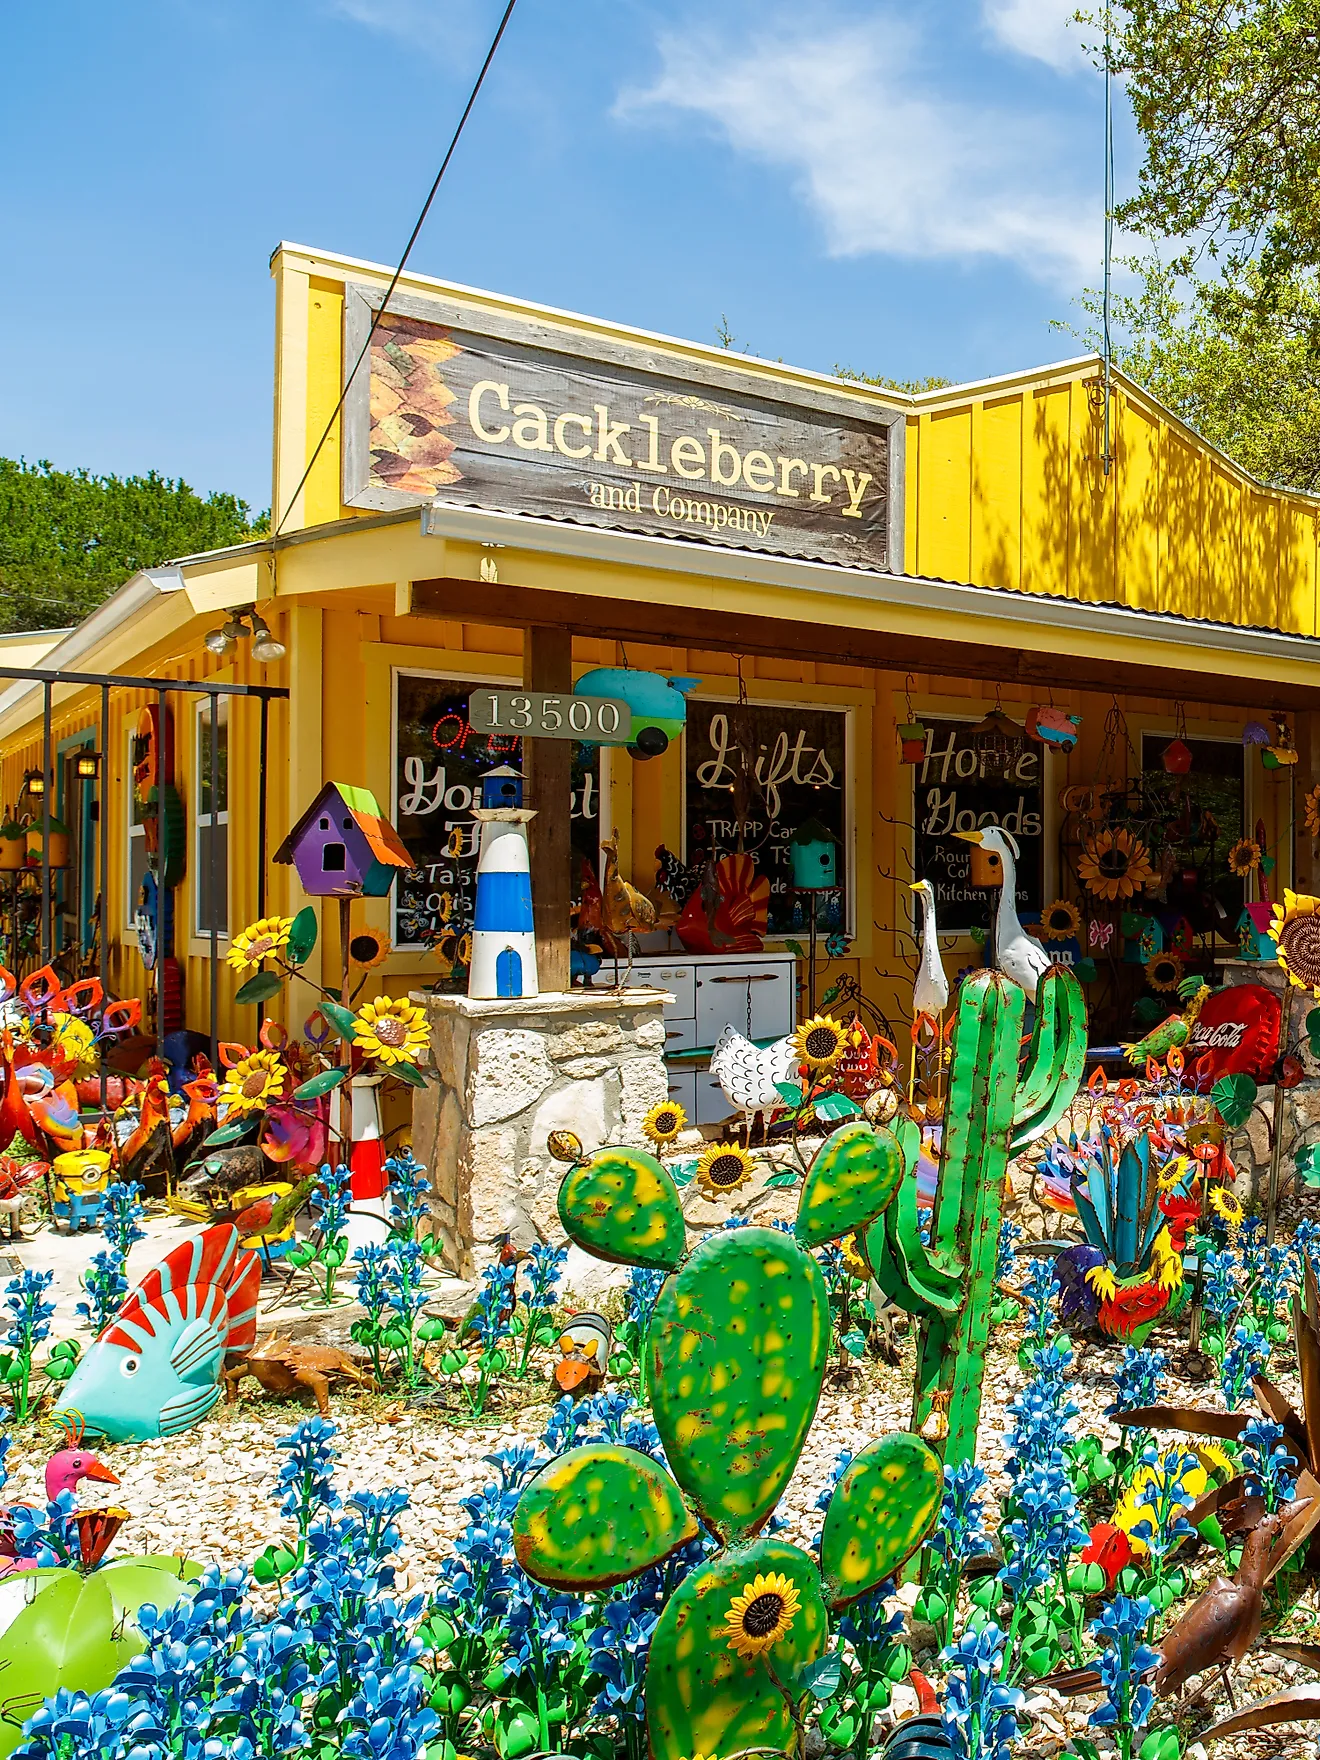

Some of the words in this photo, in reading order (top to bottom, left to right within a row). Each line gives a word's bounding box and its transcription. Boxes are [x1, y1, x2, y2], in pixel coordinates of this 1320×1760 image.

[468, 379, 874, 519] Cackleberry
[589, 481, 641, 514] and
[651, 486, 775, 539] Company
[486, 694, 620, 734] 13500
[696, 714, 842, 819] Gifts
[705, 819, 764, 838] TRAPP
[706, 846, 761, 865] Tes
[937, 883, 987, 902] Kitchen
